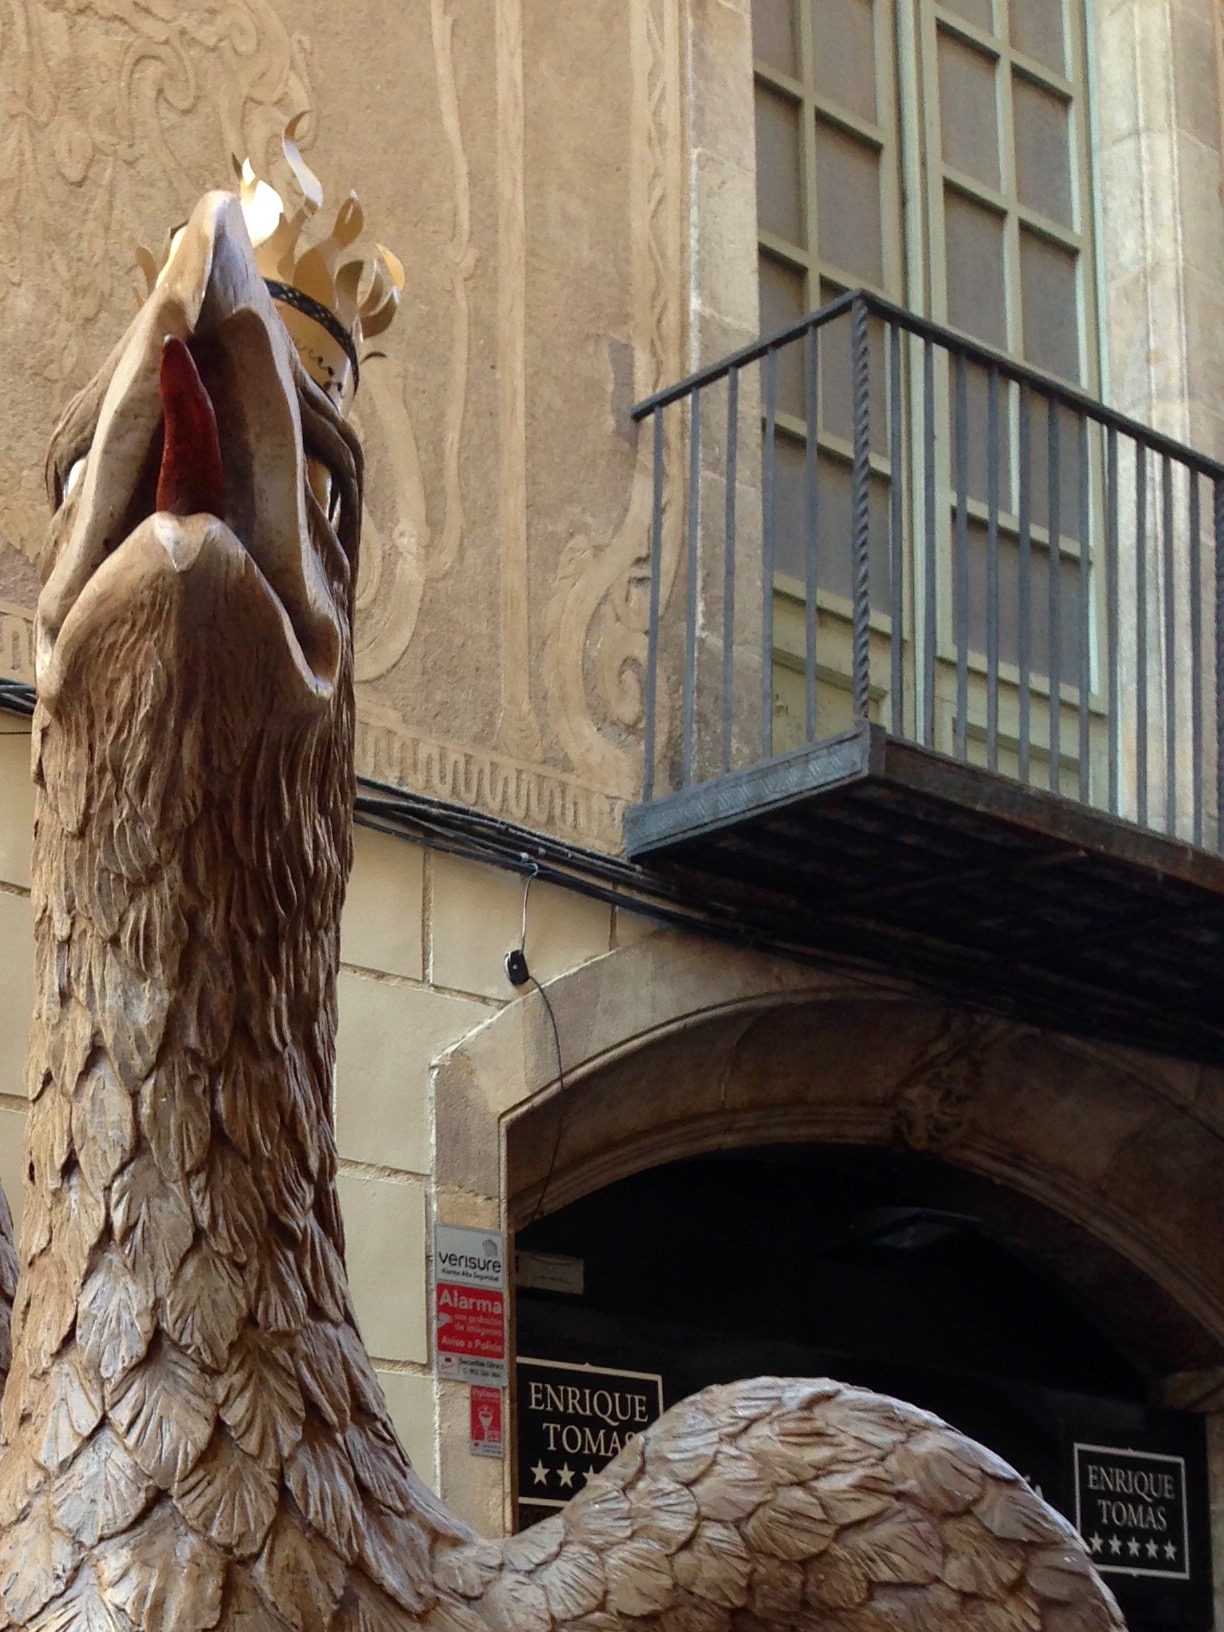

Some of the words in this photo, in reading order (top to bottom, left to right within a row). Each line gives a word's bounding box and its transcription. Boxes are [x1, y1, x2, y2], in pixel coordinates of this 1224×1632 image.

[438, 1251, 502, 1274] verisure
[438, 1289, 502, 1315] Alarma
[528, 1381, 649, 1426] ENRIQUE
[1086, 1464, 1176, 1503] ENRIQUE
[1097, 1499, 1168, 1532] TOMAS
